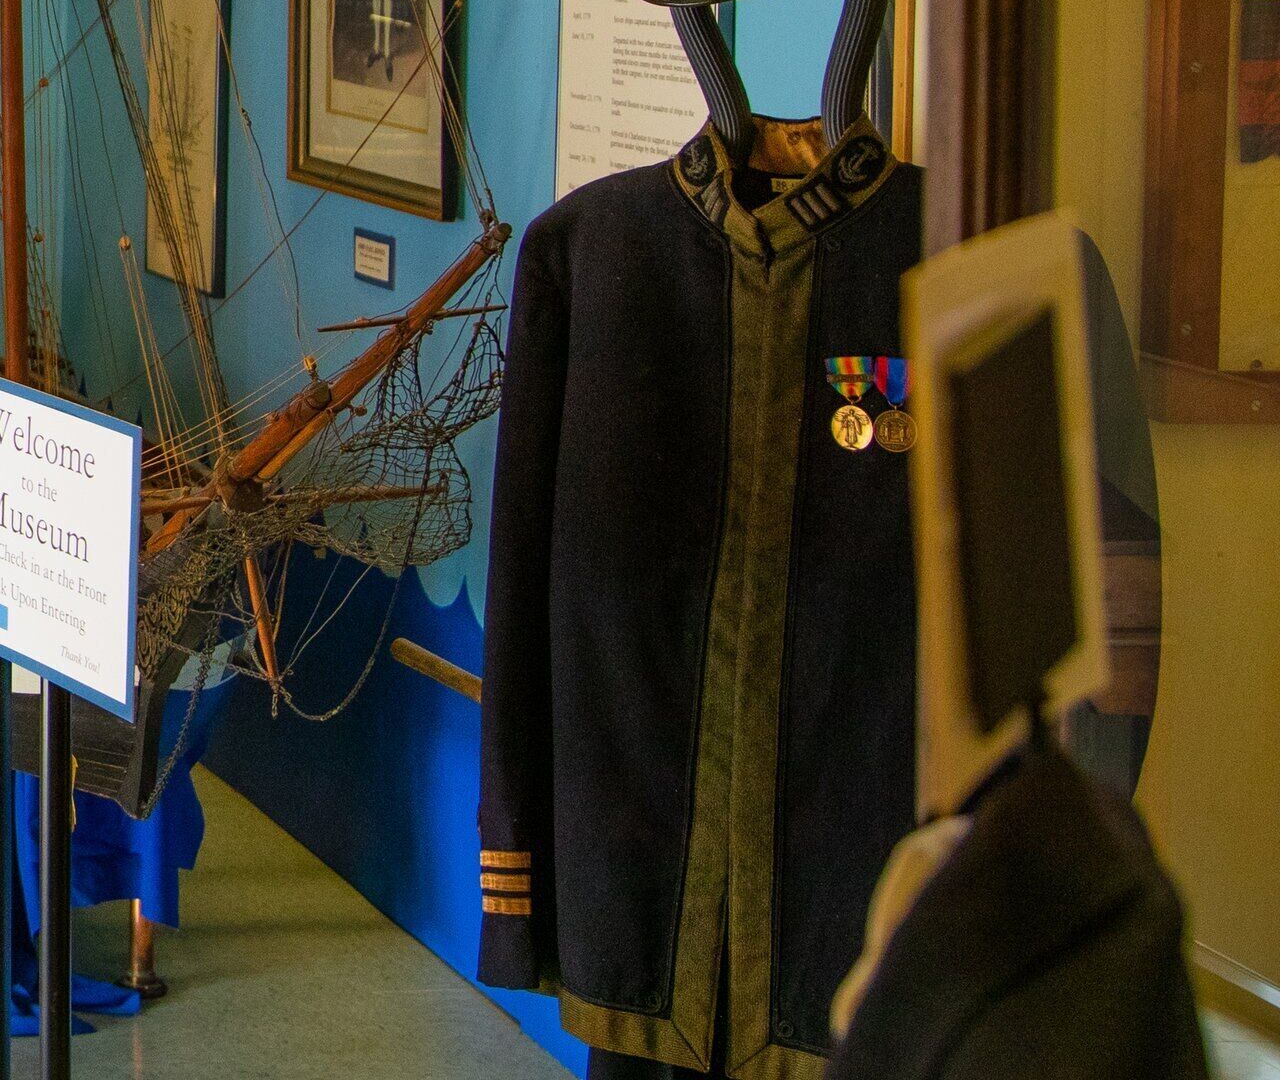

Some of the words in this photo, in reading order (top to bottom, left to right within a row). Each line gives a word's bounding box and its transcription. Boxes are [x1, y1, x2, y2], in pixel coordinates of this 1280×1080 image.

[21, 476, 33, 494] to
[38, 480, 58, 502] the
[31, 556, 40, 576] in
[42, 561, 54, 581] at
[58, 564, 74, 589] the
[77, 577, 107, 605] Front
[11, 584, 38, 614] Upon
[41, 598, 86, 636] Entering
[60, 645, 83, 666] Thank
[84, 654, 101, 675] You!
